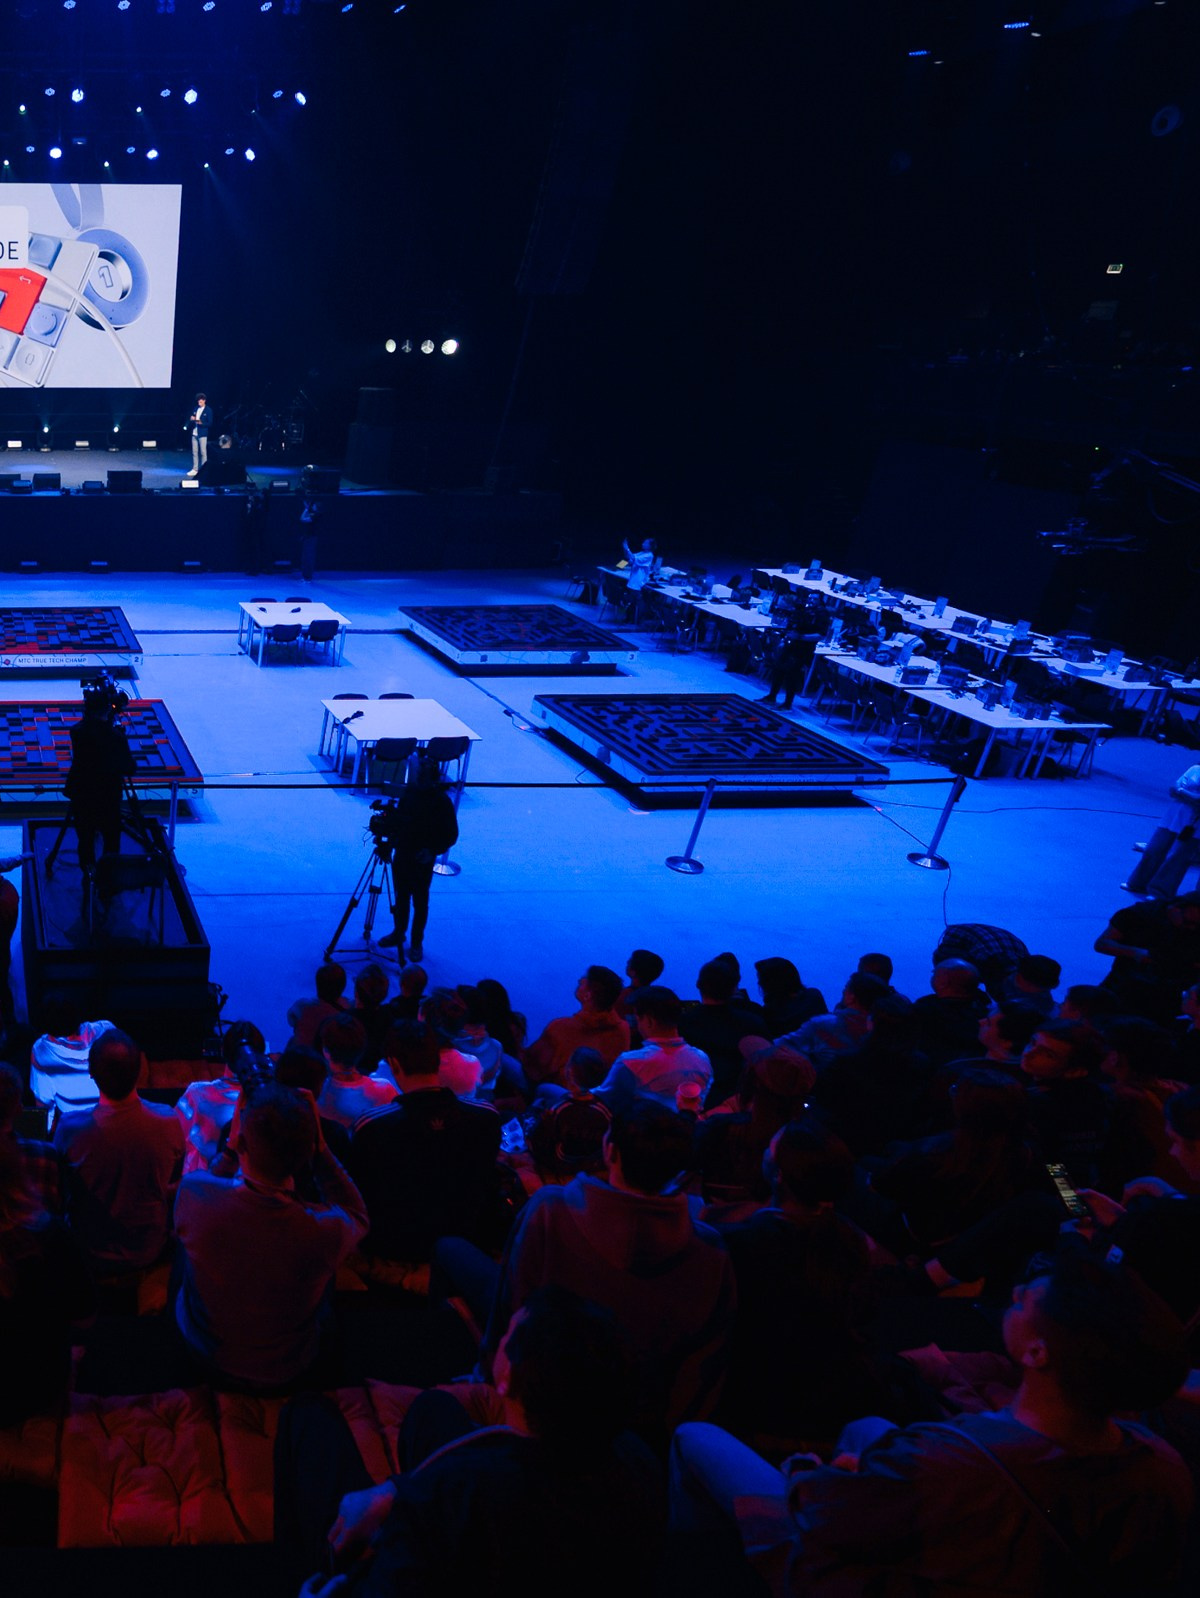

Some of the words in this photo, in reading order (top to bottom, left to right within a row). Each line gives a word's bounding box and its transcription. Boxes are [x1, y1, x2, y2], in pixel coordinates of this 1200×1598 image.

[32, 656, 48, 664] TRUE
[48, 656, 64, 664] TECH
[64, 656, 87, 664] CHAMP
